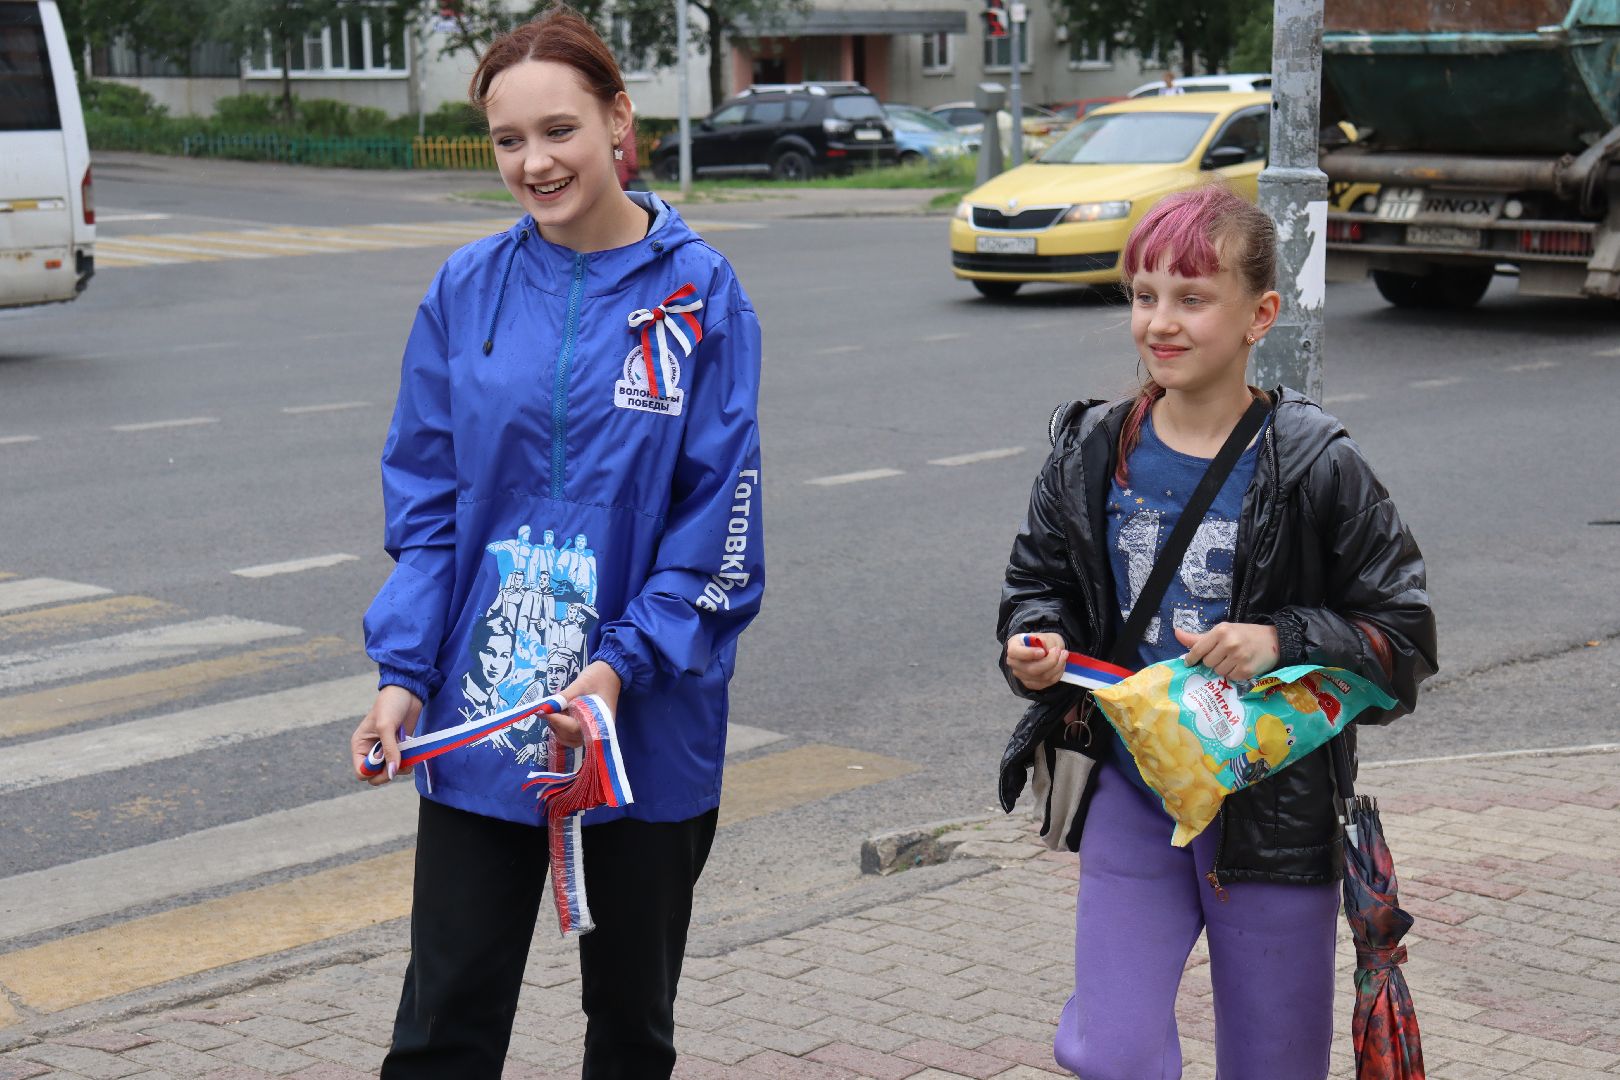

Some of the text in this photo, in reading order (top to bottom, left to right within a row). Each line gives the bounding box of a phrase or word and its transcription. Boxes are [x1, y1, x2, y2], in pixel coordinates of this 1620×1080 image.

[619, 387, 680, 403] ВОЛОНЫ
[628, 398, 670, 412] ПОБЕДЫ
[1204, 681, 1240, 726] ВЫИГРАЙ
